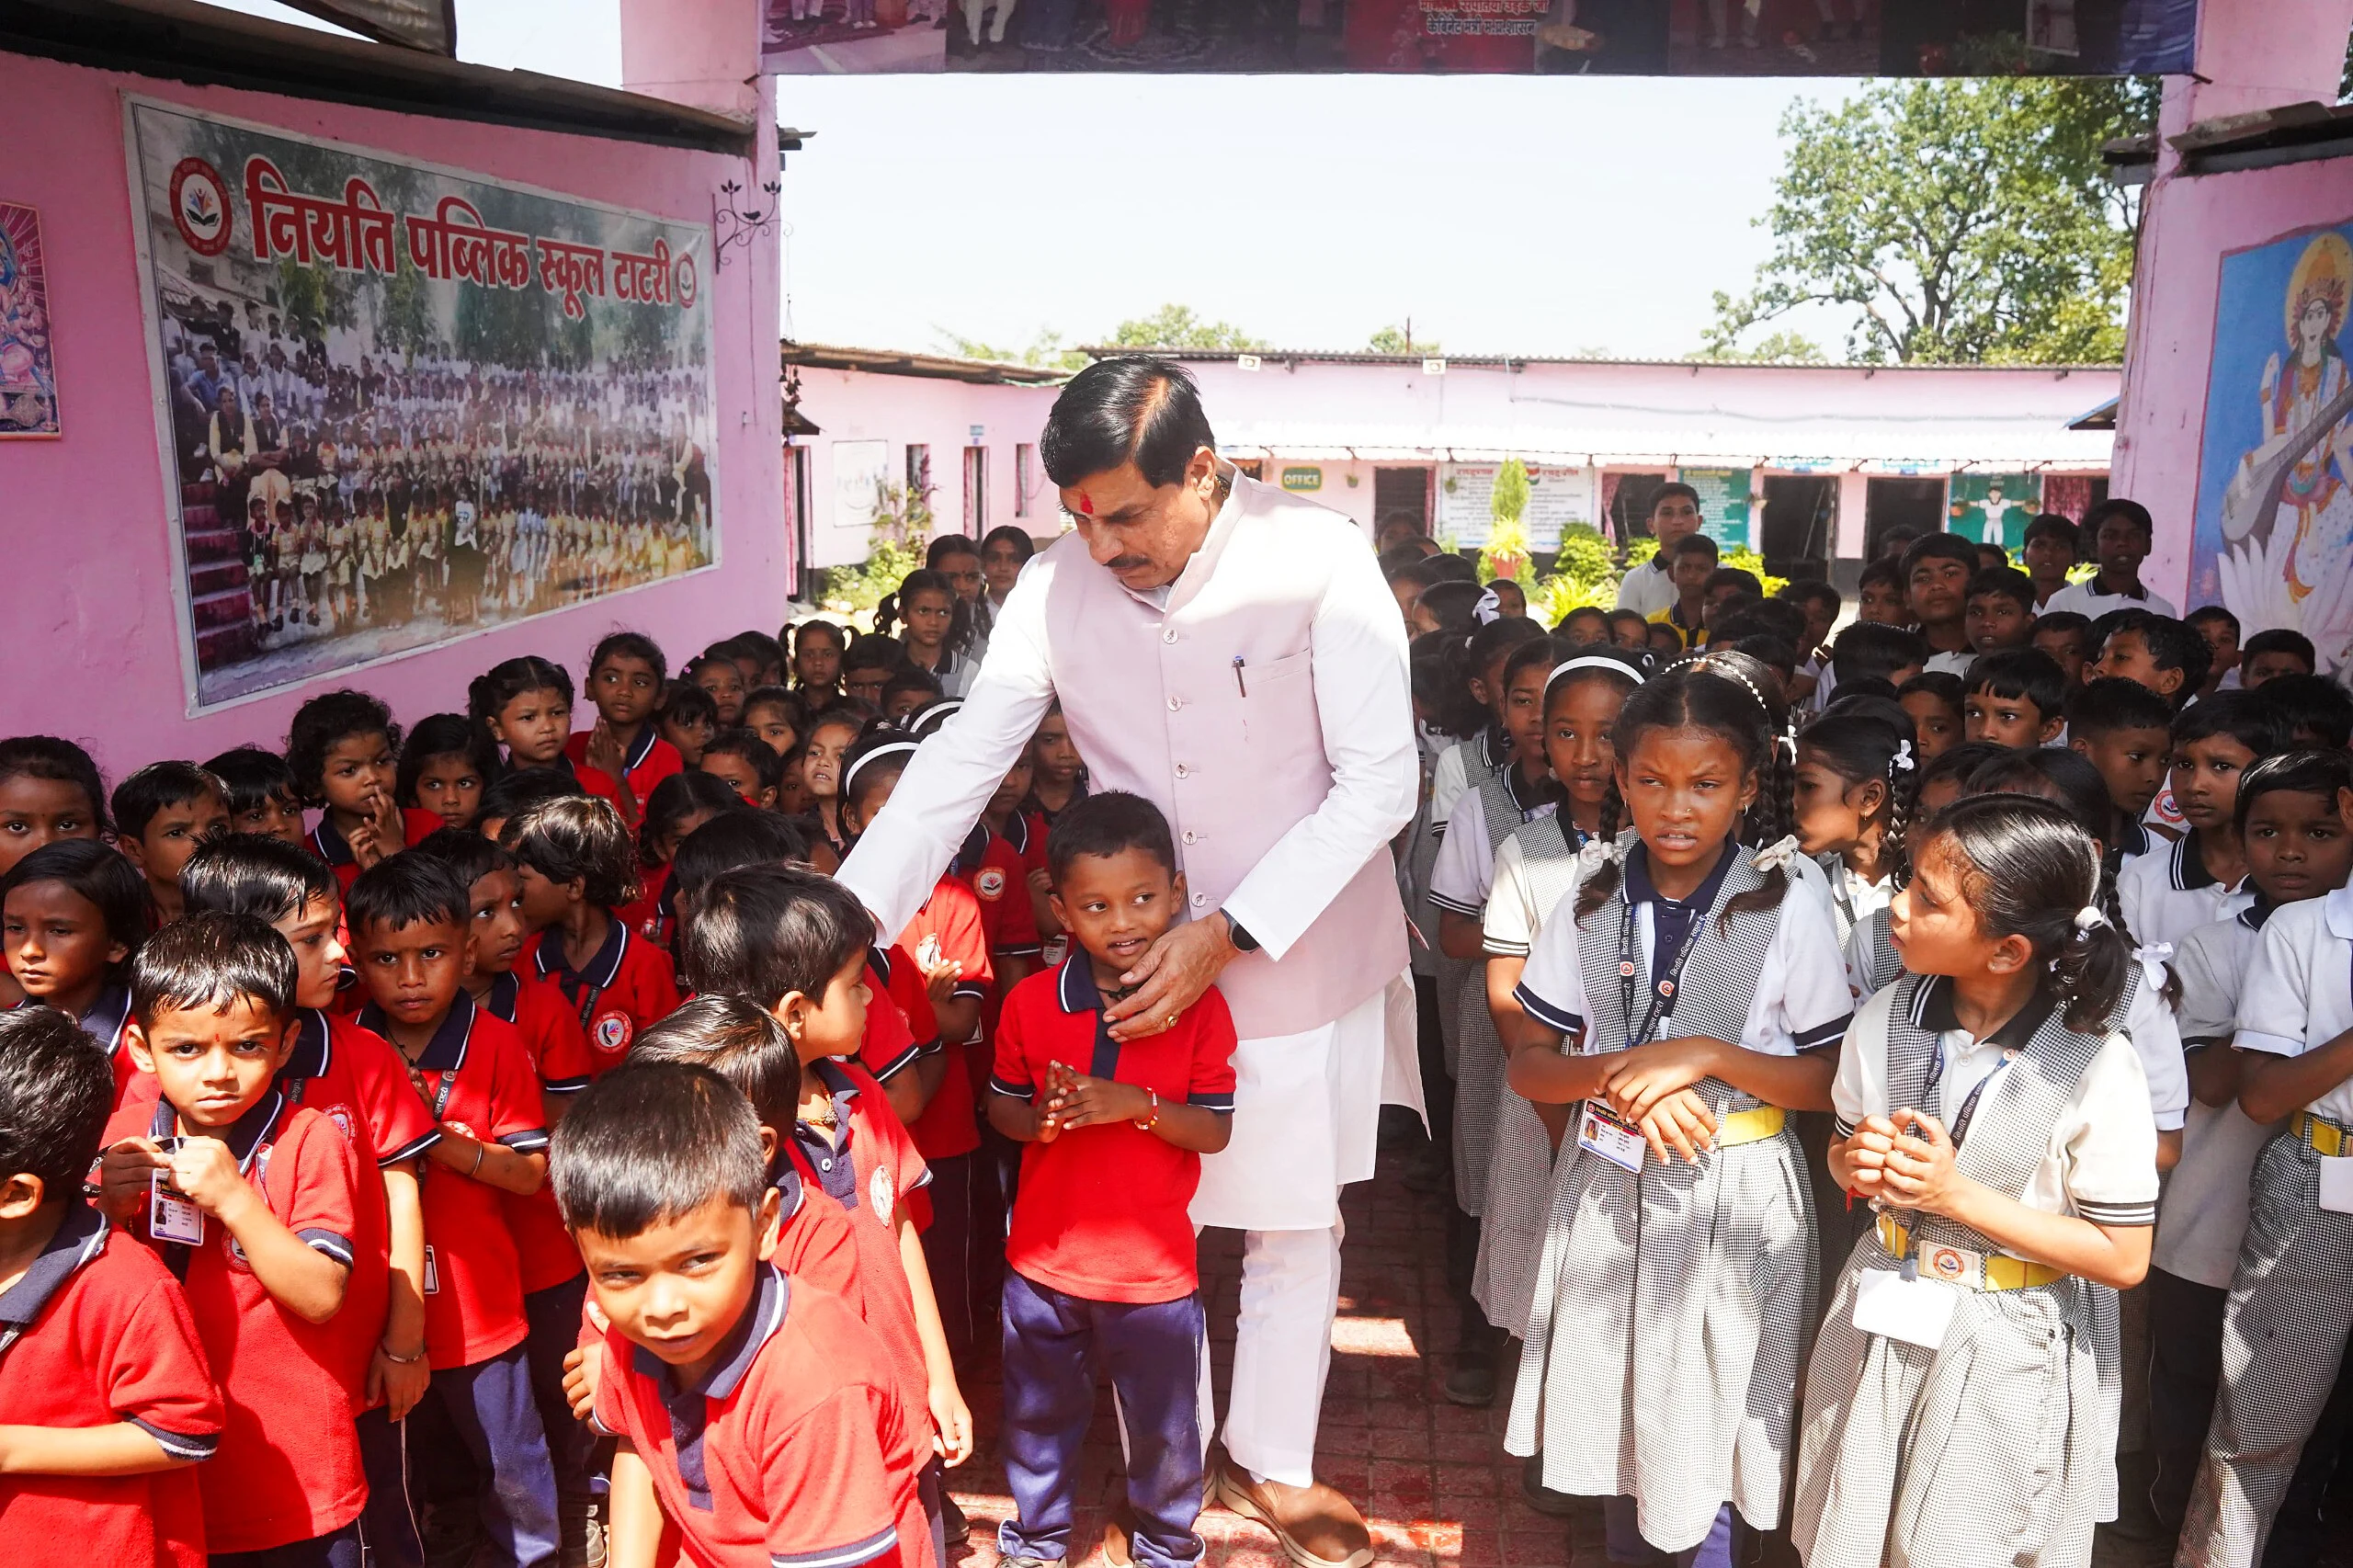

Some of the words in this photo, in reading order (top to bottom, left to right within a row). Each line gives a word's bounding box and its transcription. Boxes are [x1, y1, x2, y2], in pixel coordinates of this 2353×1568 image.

[245, 154, 396, 274] नियति
[406, 197, 529, 290] पब्लिक
[538, 238, 605, 322] स्कूल
[613, 238, 672, 308] टाटरी
[1284, 474, 1319, 485] OFFICE
[1670, 958, 1683, 976] नियति
[1680, 937, 1694, 958] पब्लिक
[1691, 920, 1701, 937] स्कूल
[1647, 1017, 1657, 1033] स्कूल
[1654, 1000, 1665, 1017] टाटरी
[1928, 1061, 1941, 1084] पब्लिक
[438, 1086, 449, 1103] टाटरी
[1953, 1119, 1966, 1141] नियति
[1962, 1096, 1976, 1119] पब्लिक
